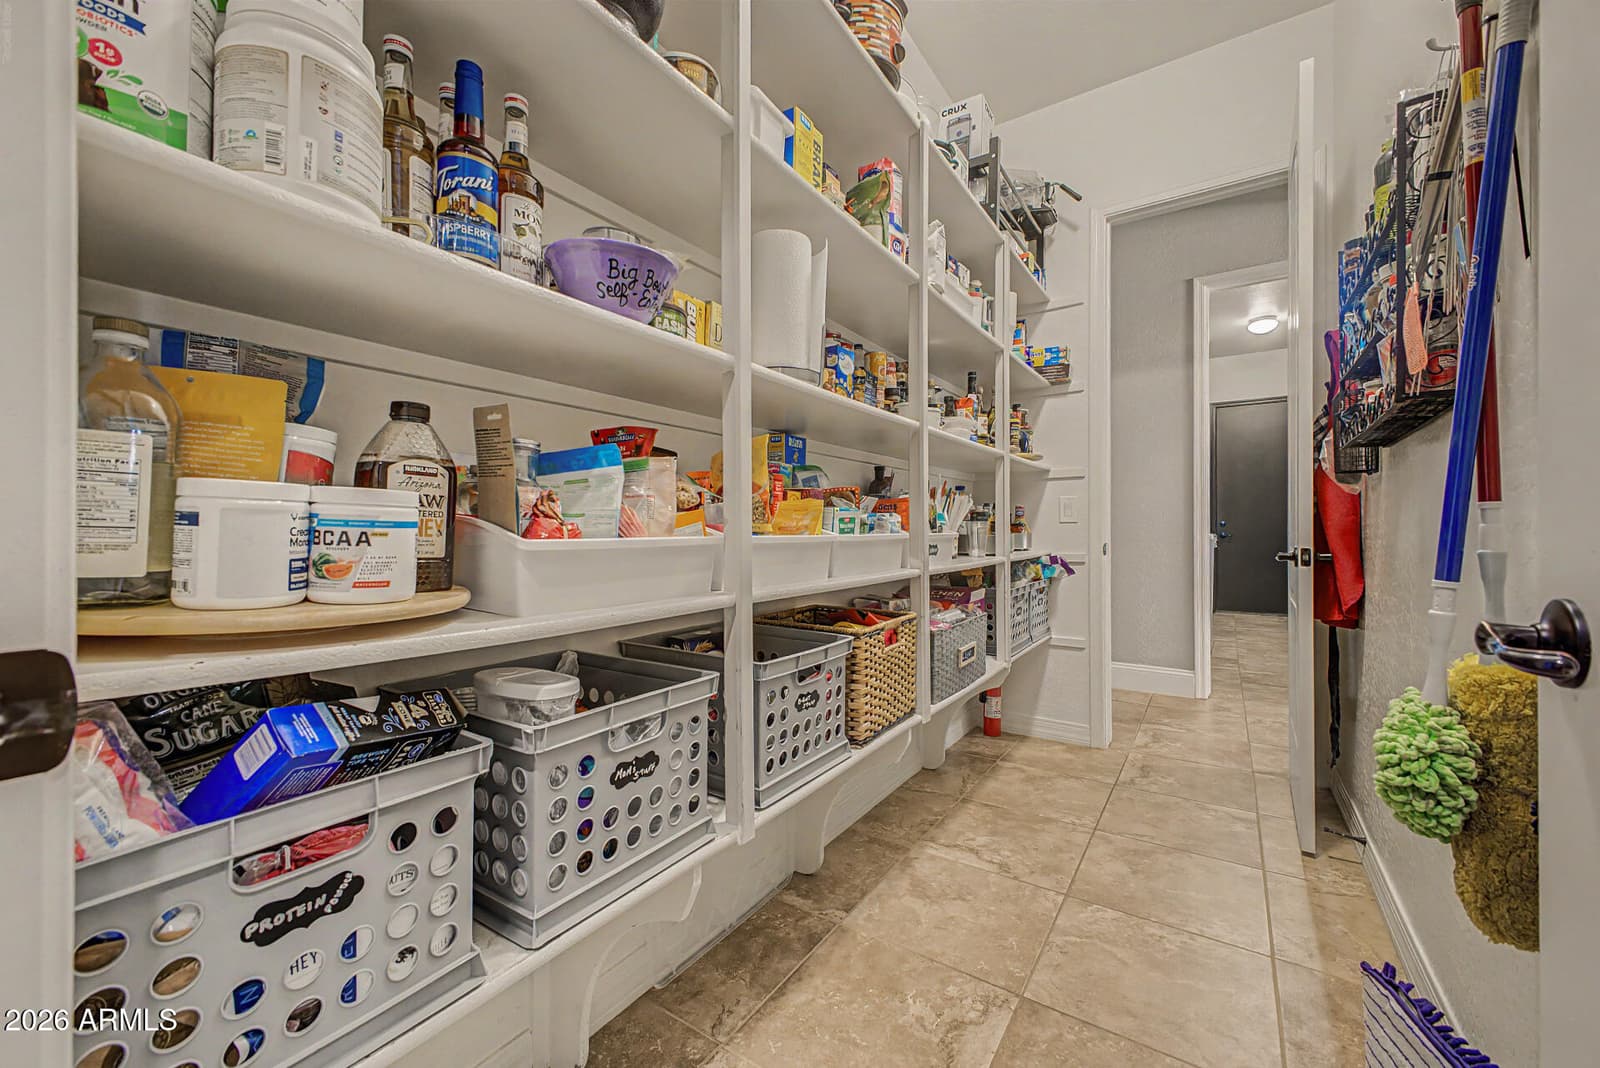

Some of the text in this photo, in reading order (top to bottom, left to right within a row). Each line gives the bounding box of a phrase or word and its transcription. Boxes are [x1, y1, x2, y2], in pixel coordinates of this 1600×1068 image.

[941, 102, 968, 118] CRUX
[437, 164, 494, 200] Torani
[606, 257, 639, 291] Big
[313, 530, 372, 547] BCAA
[180, 700, 224, 722] CANE
[143, 707, 261, 759] SUGAR
[244, 893, 327, 940] PROTEIN
